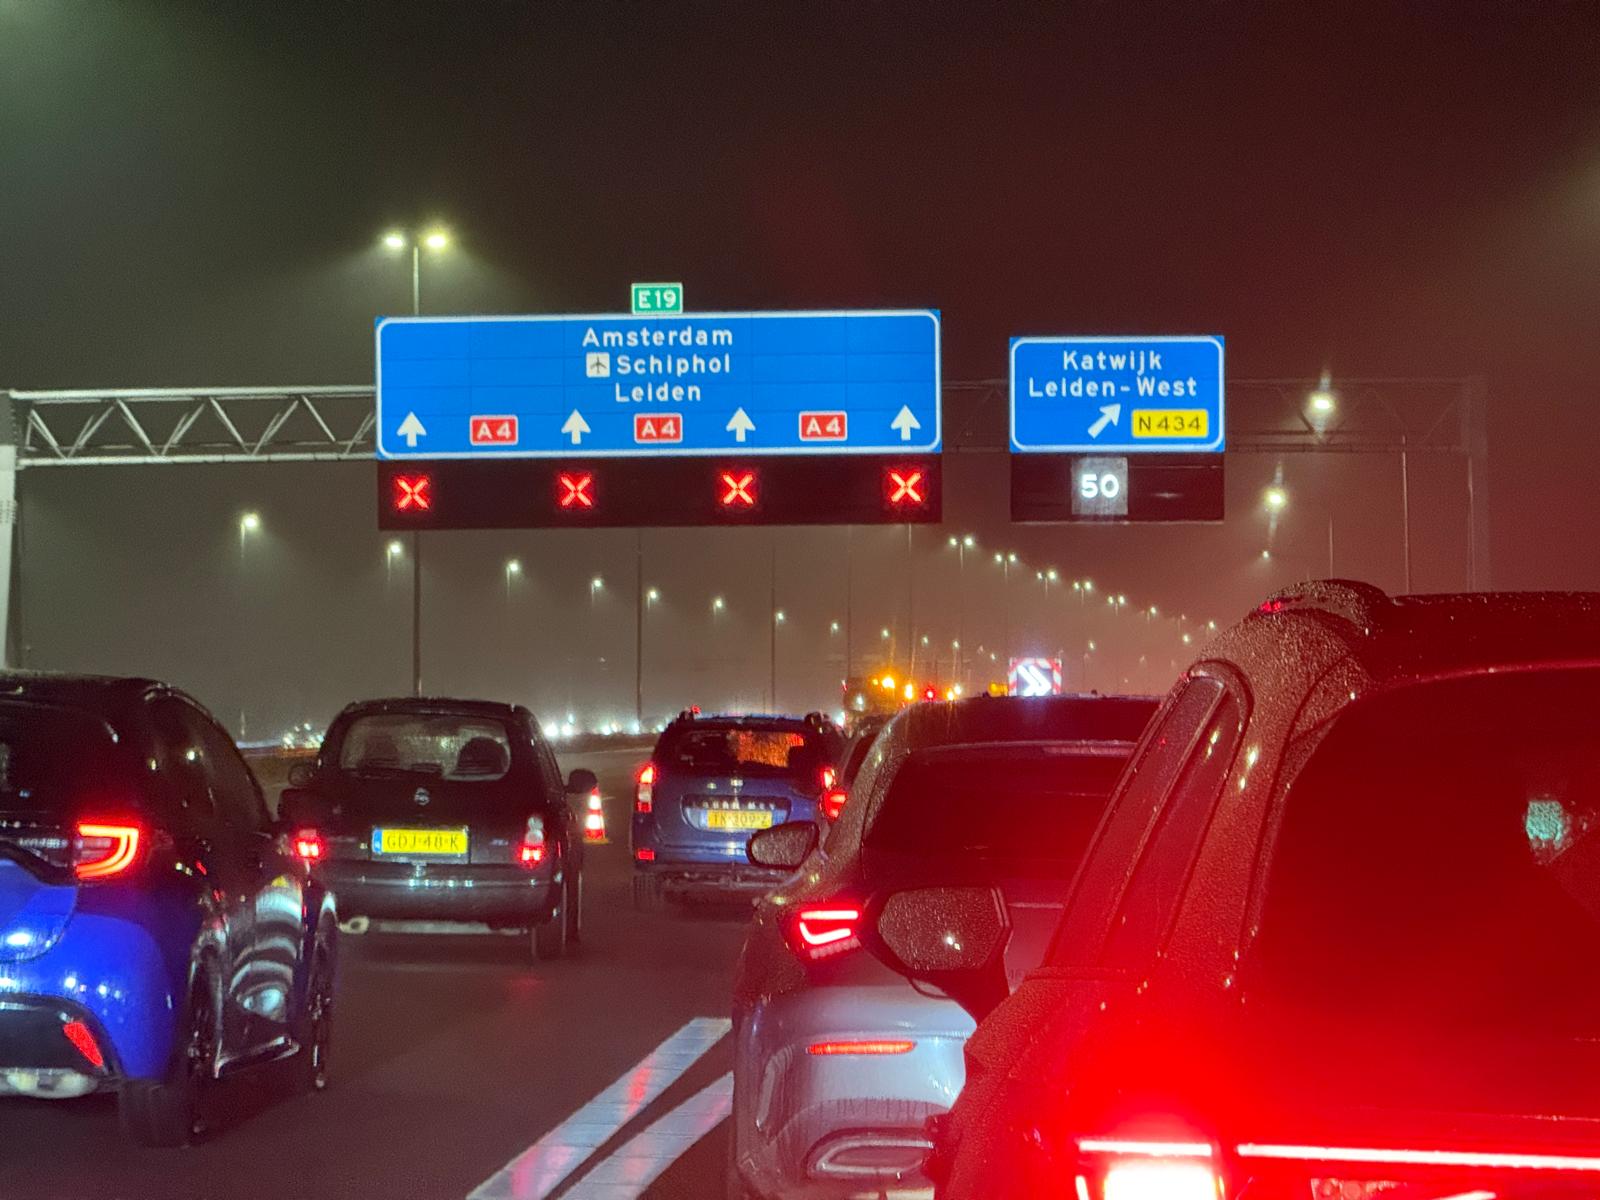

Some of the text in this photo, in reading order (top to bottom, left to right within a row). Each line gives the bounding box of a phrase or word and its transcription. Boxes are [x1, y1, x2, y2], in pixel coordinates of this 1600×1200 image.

[638, 290, 677, 308] E19
[582, 326, 733, 346] Amsterdam
[617, 353, 731, 376] Schiphol
[1063, 350, 1162, 375] Katwijk
[615, 383, 701, 402] Leiden
[1029, 377, 1197, 397] Leiden-West
[1138, 416, 1201, 432] N434
[1081, 474, 1119, 498] 50
[387, 833, 460, 851] GDJ-48-K
